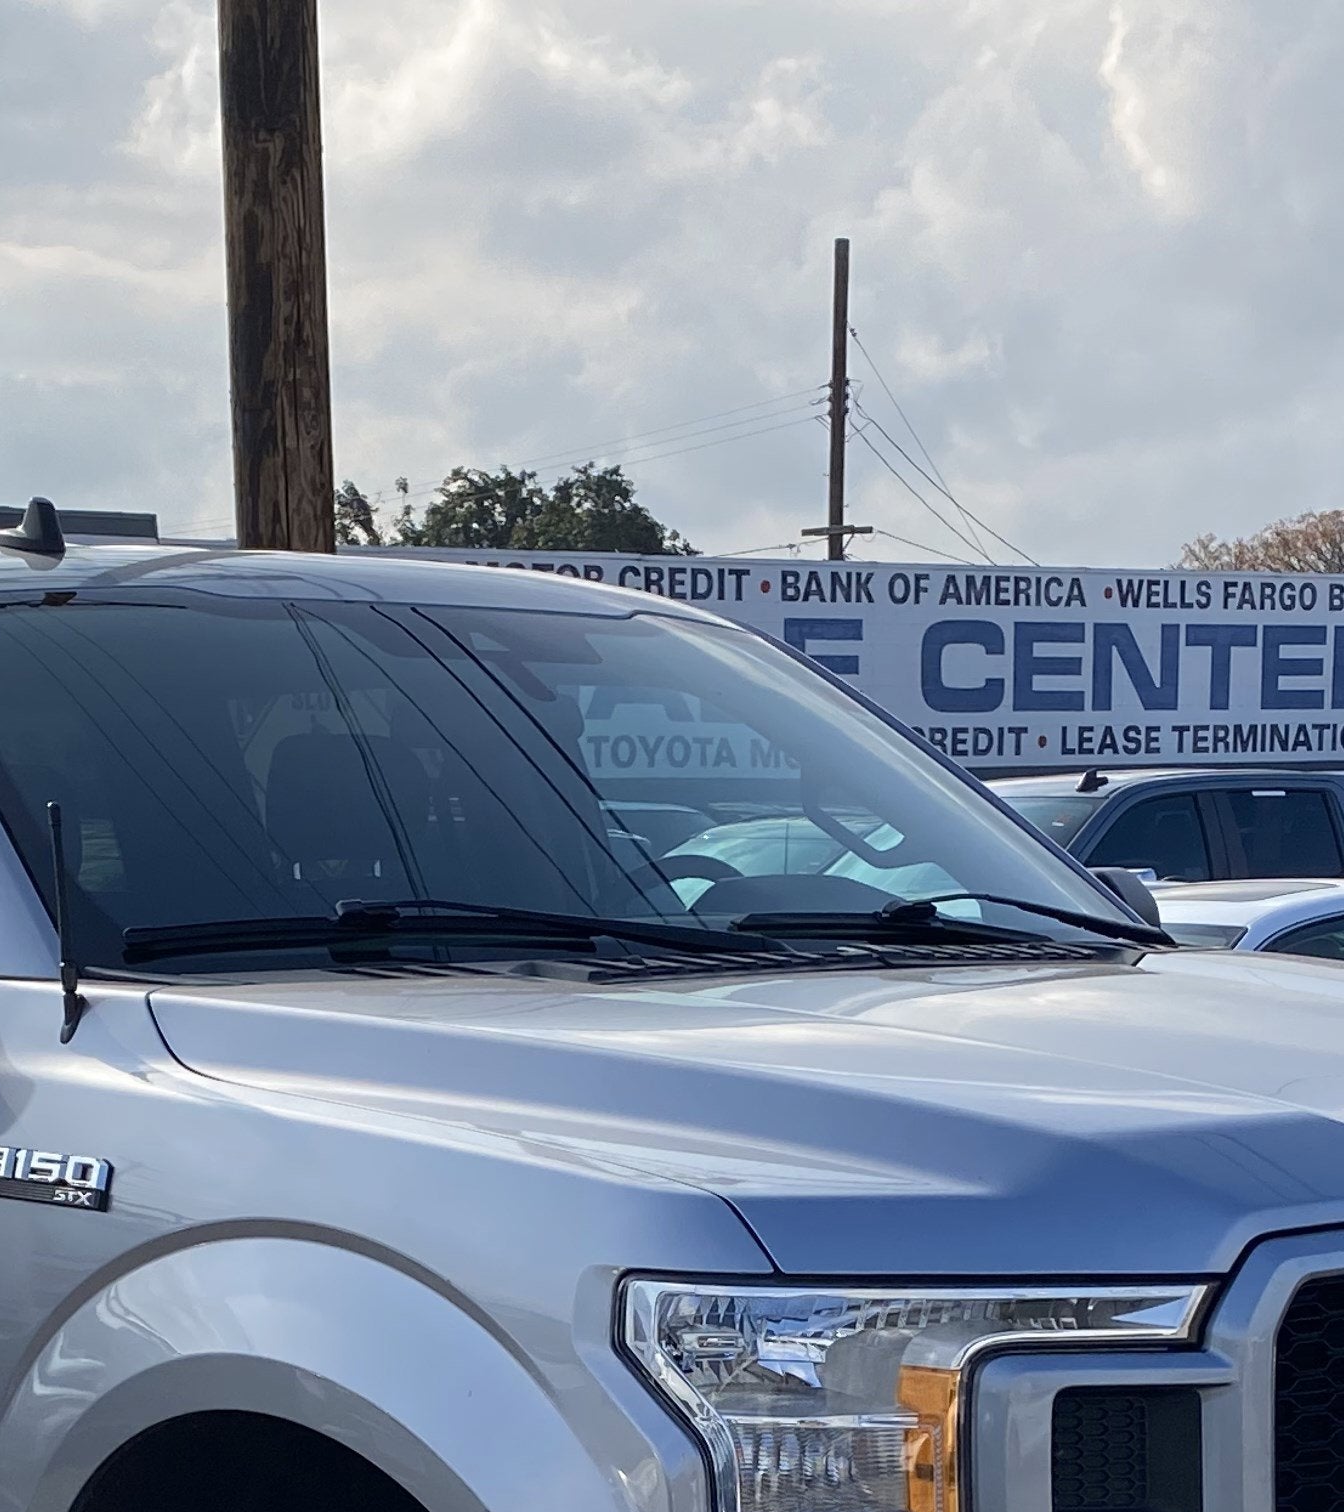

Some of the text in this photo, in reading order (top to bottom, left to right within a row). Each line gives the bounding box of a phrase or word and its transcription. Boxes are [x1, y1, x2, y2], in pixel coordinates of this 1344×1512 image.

[618, 566, 751, 601] CREDIT
[780, 570, 875, 604] BANK
[887, 572, 930, 604] OF
[938, 574, 1087, 608] AMERICA
[1115, 578, 1212, 610] WELLS
[1222, 581, 1318, 612] FARGO
[587, 735, 737, 769] TOYOTA
[910, 727, 1028, 756] REDIT
[1060, 725, 1161, 756] LEASE
[52, 1190, 93, 1206] STX
